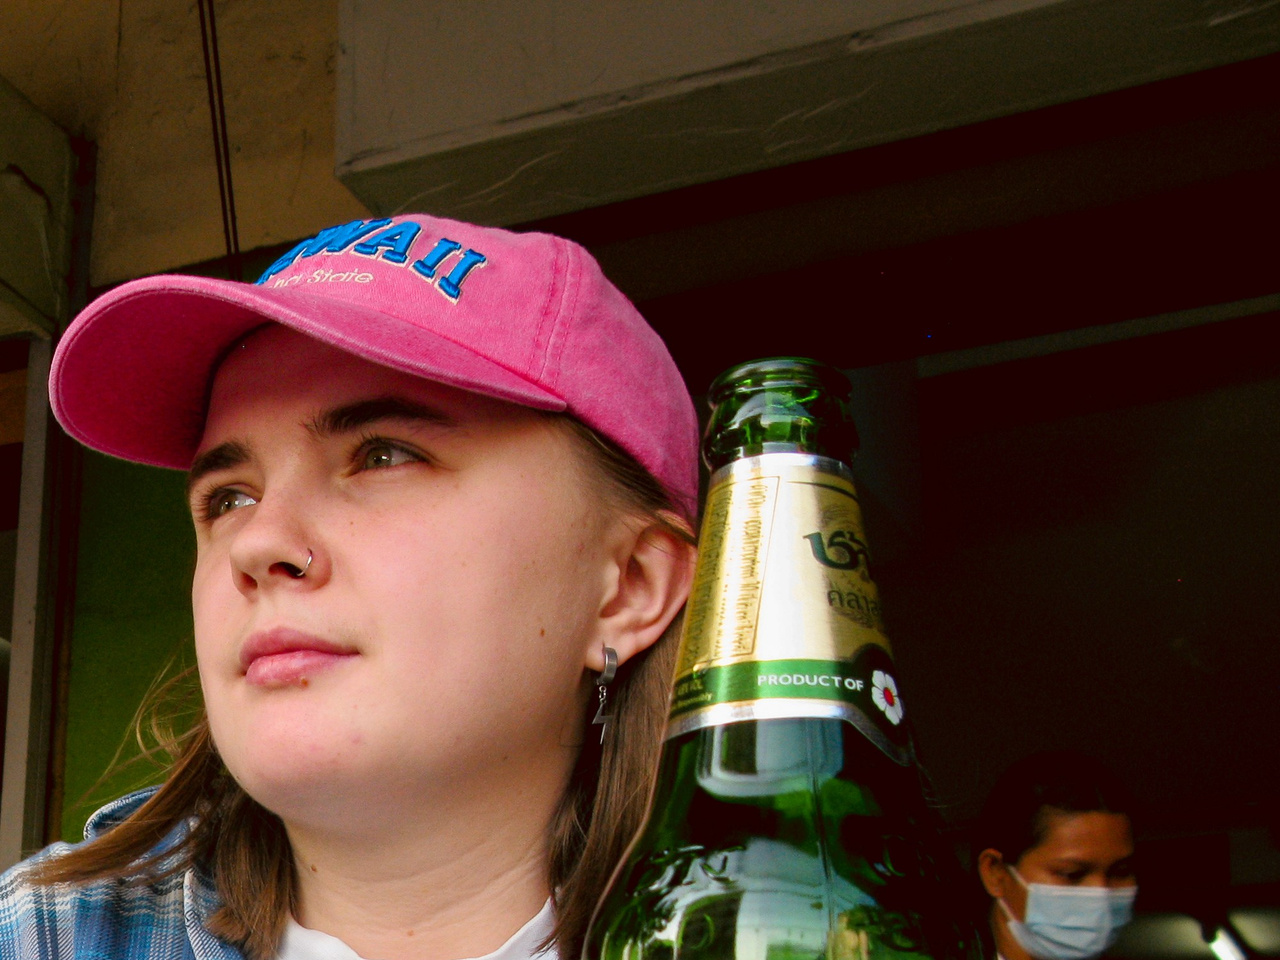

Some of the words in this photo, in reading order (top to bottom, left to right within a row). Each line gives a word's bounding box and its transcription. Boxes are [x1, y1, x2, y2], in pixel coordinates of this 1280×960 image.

[307, 268, 375, 284] State
[757, 674, 842, 688] PRODUCT
[844, 678, 865, 692] OF
